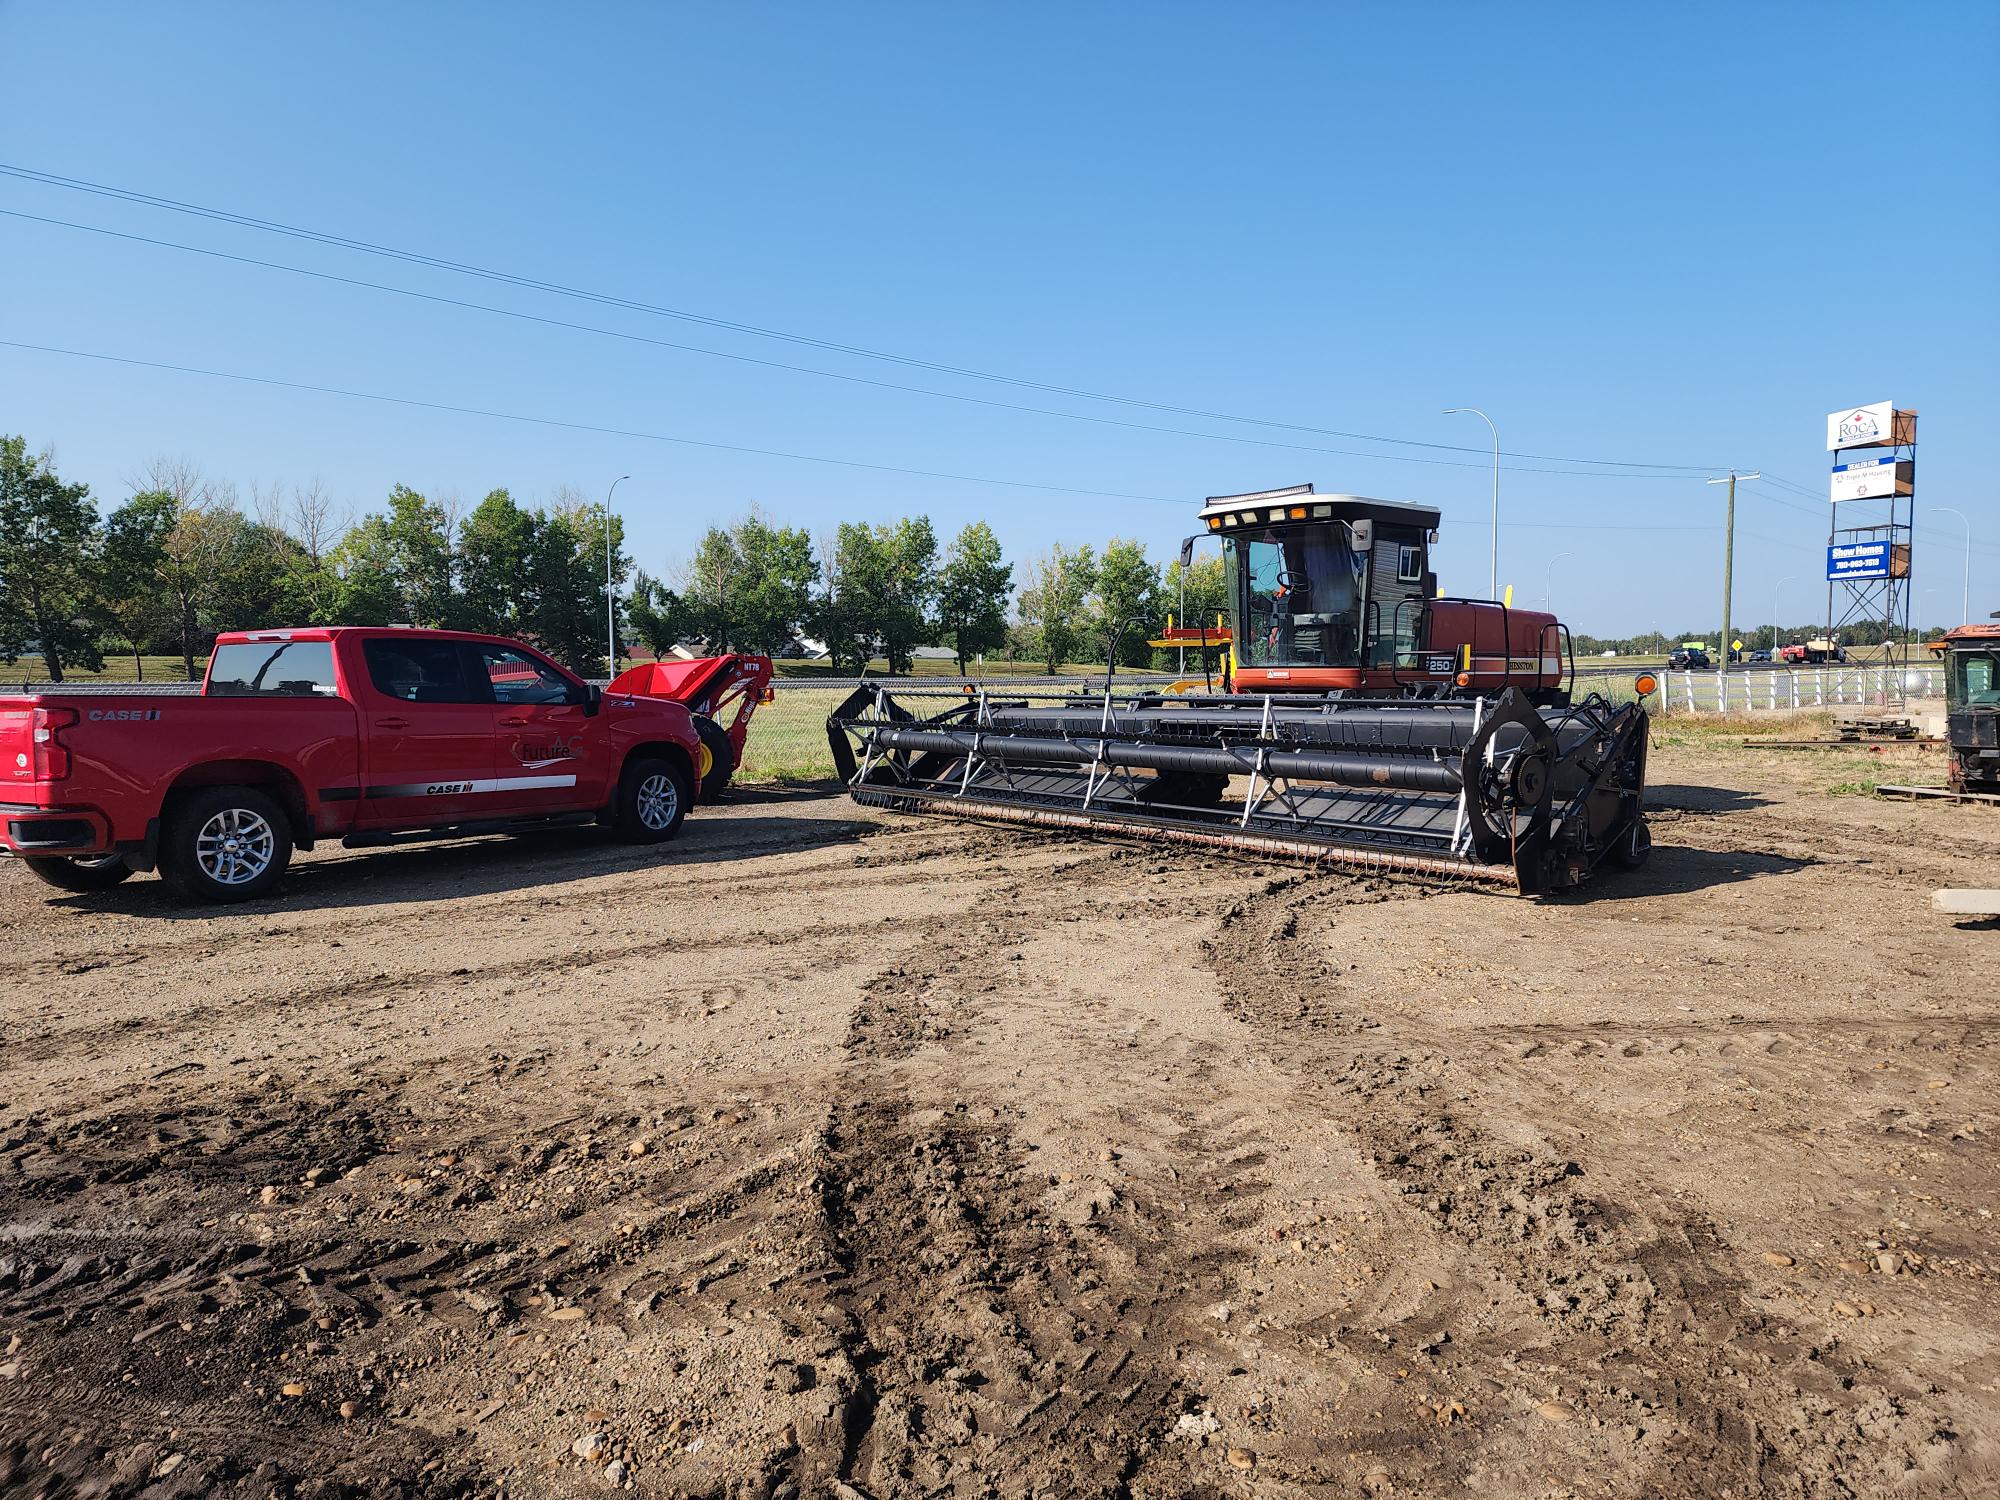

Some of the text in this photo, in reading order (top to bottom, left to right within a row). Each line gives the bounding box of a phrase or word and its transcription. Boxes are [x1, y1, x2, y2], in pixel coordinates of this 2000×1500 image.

[1839, 418, 1878, 437] ROCA
[1867, 459, 1879, 468] FOR
[1832, 545, 1884, 558] Show Homes
[88, 710, 142, 721] CASE
[522, 743, 570, 760] Future
[426, 782, 474, 794] CASE IH
